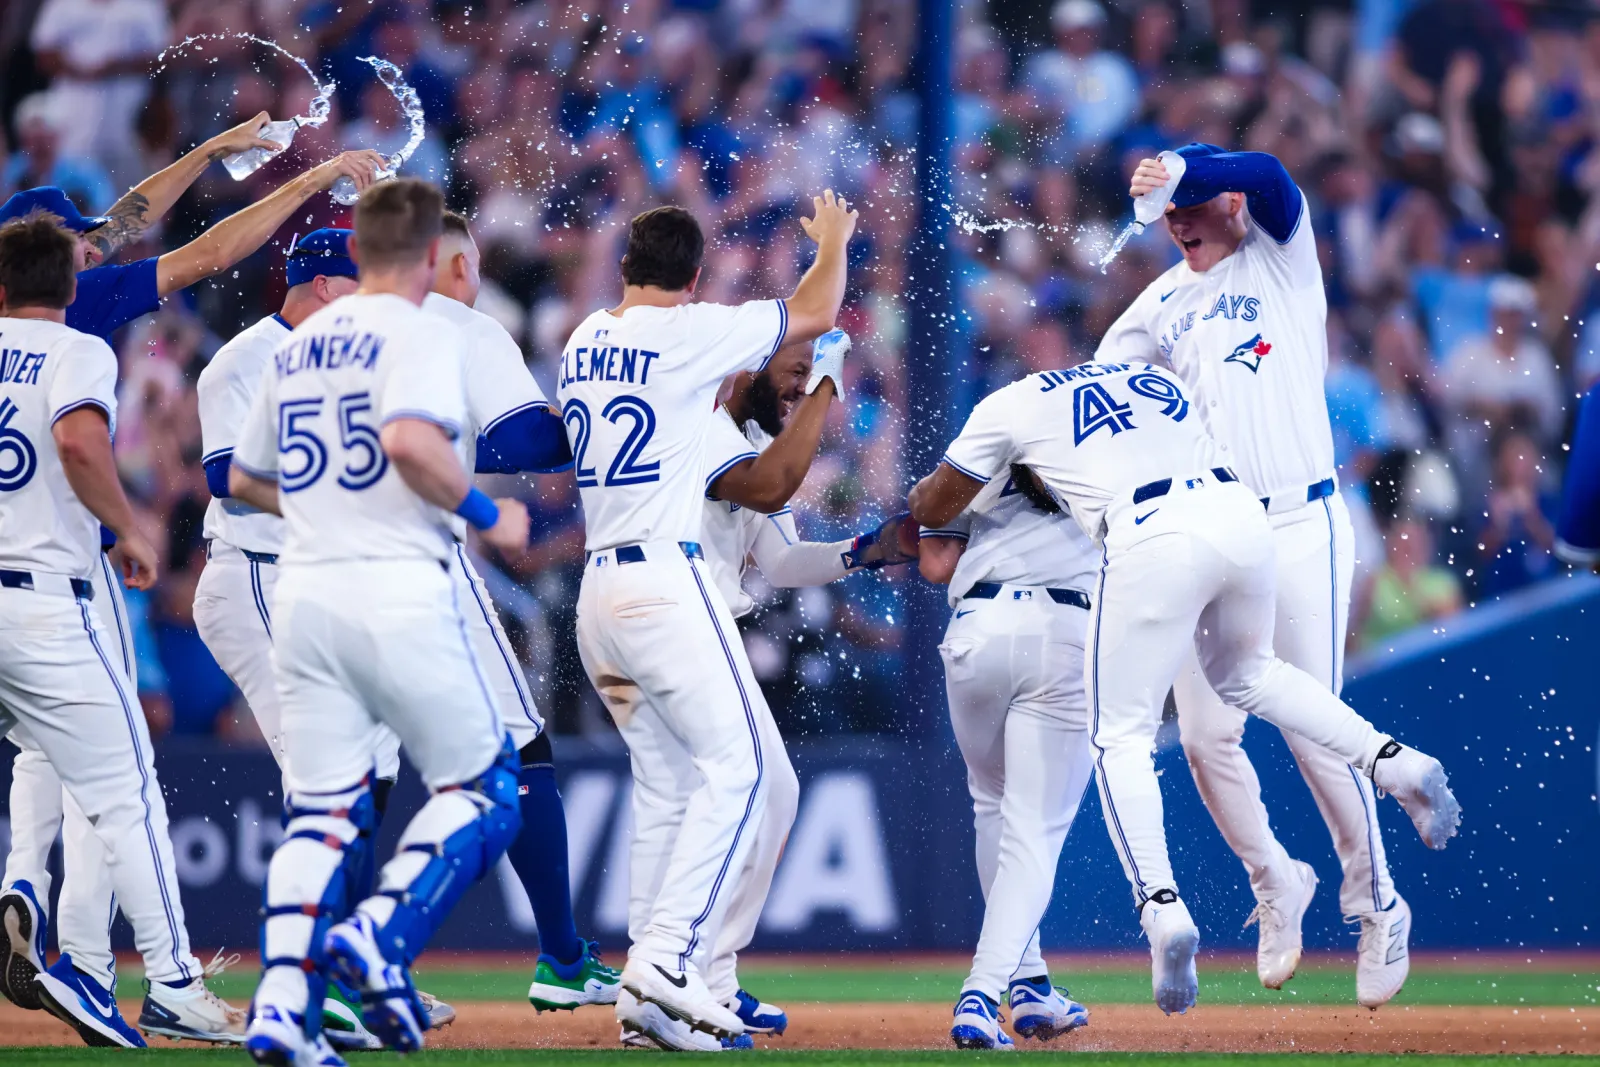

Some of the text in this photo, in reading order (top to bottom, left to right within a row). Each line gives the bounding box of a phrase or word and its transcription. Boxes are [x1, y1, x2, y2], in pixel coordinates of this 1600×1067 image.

[1202, 292, 1261, 322] JAYS
[560, 347, 660, 389] CLEMENT
[279, 390, 388, 493] 55
[562, 395, 660, 488] 22
[1073, 373, 1189, 447] 49
[502, 770, 897, 932] VIA
